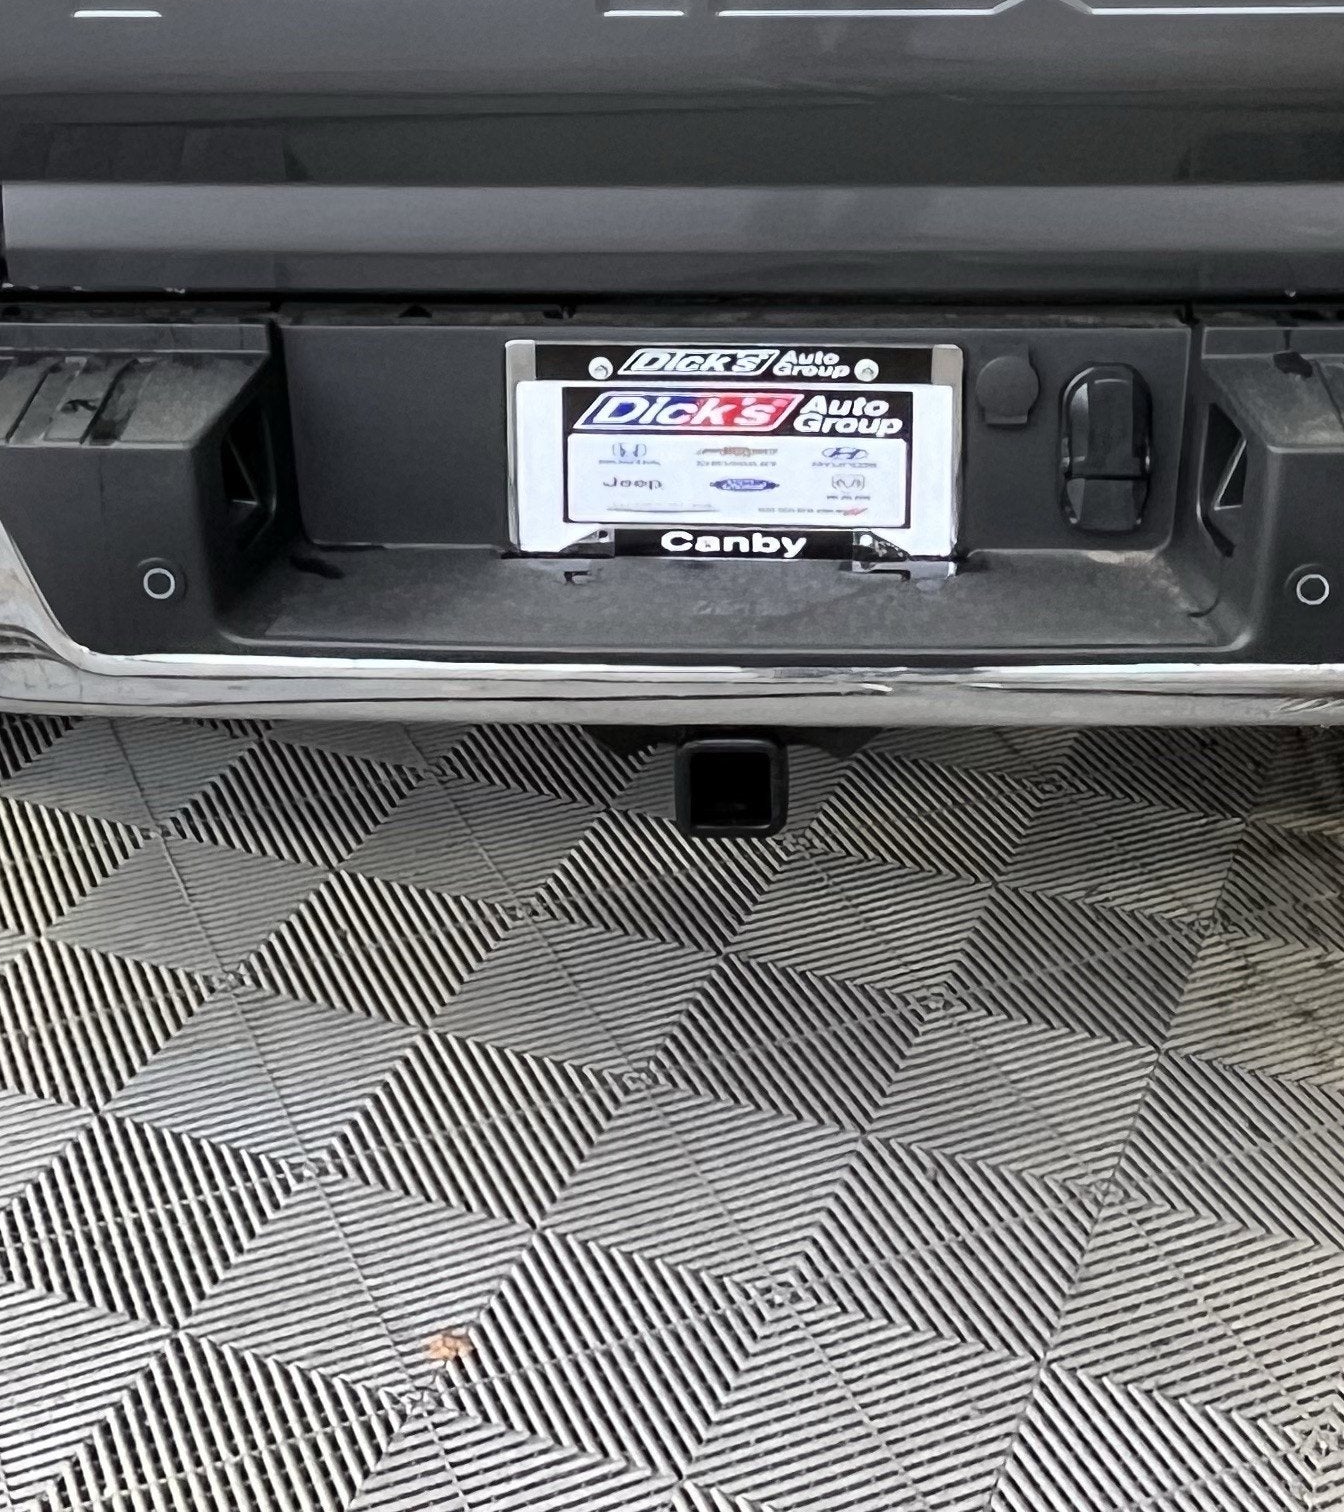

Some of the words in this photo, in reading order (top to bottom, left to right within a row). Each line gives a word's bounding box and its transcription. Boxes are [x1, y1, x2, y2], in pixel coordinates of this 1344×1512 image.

[779, 350, 840, 366] Auto
[772, 363, 851, 379] Group
[799, 394, 890, 417] Auto
[792, 413, 903, 437] Group
[660, 530, 807, 558] Canby
